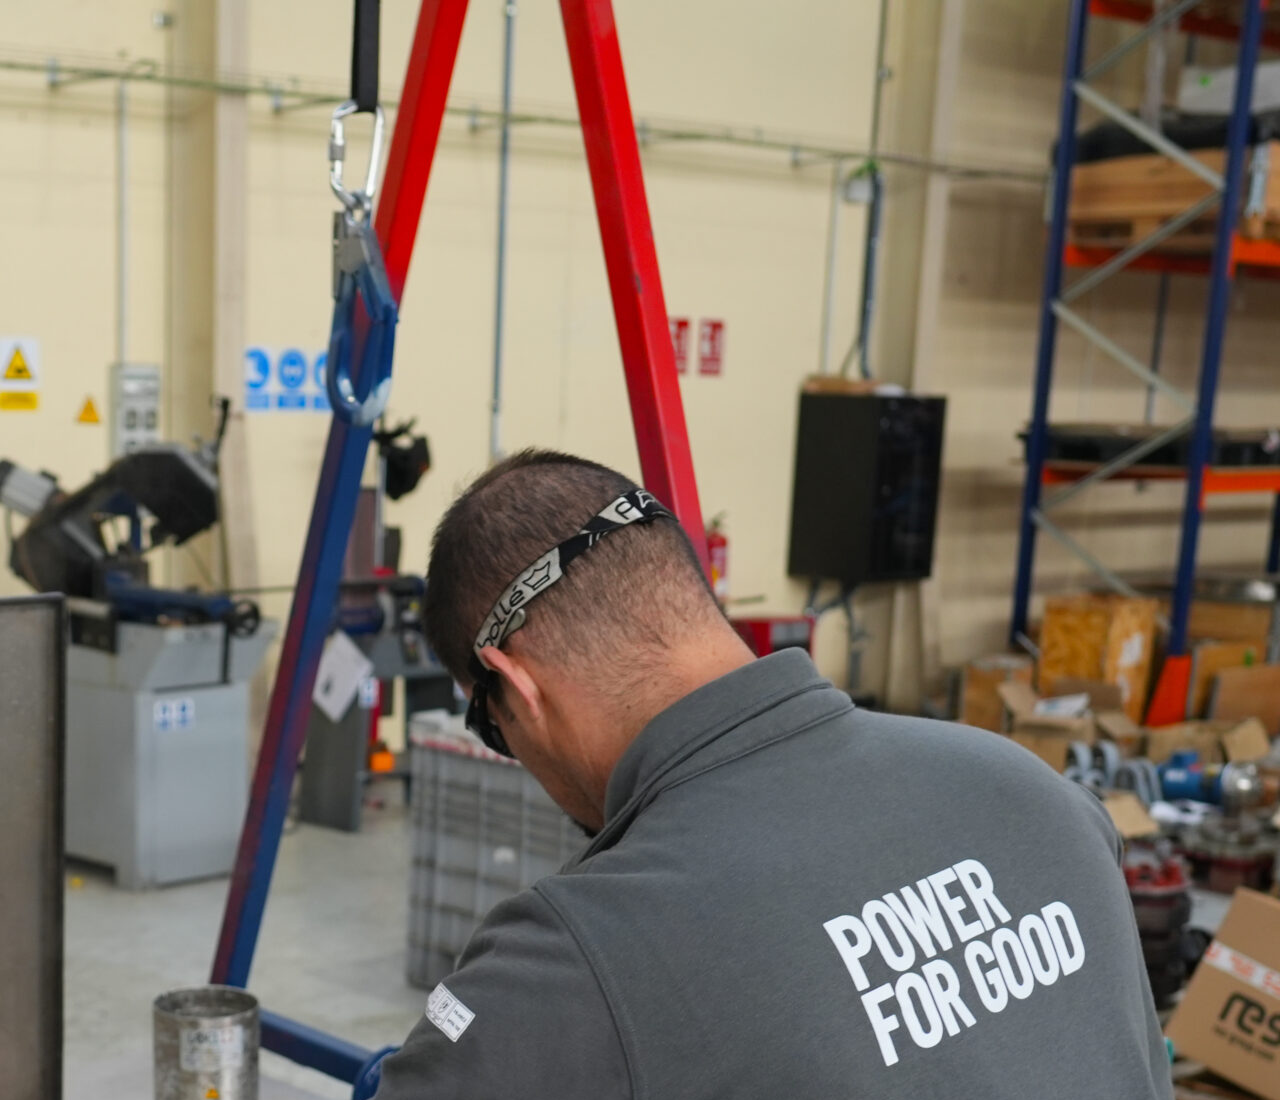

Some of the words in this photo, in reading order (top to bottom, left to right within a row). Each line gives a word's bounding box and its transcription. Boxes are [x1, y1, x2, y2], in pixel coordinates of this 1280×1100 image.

[823, 859, 1012, 991] POWER
[860, 959, 977, 1067] FOR
[964, 901, 1086, 1013] GOOD
